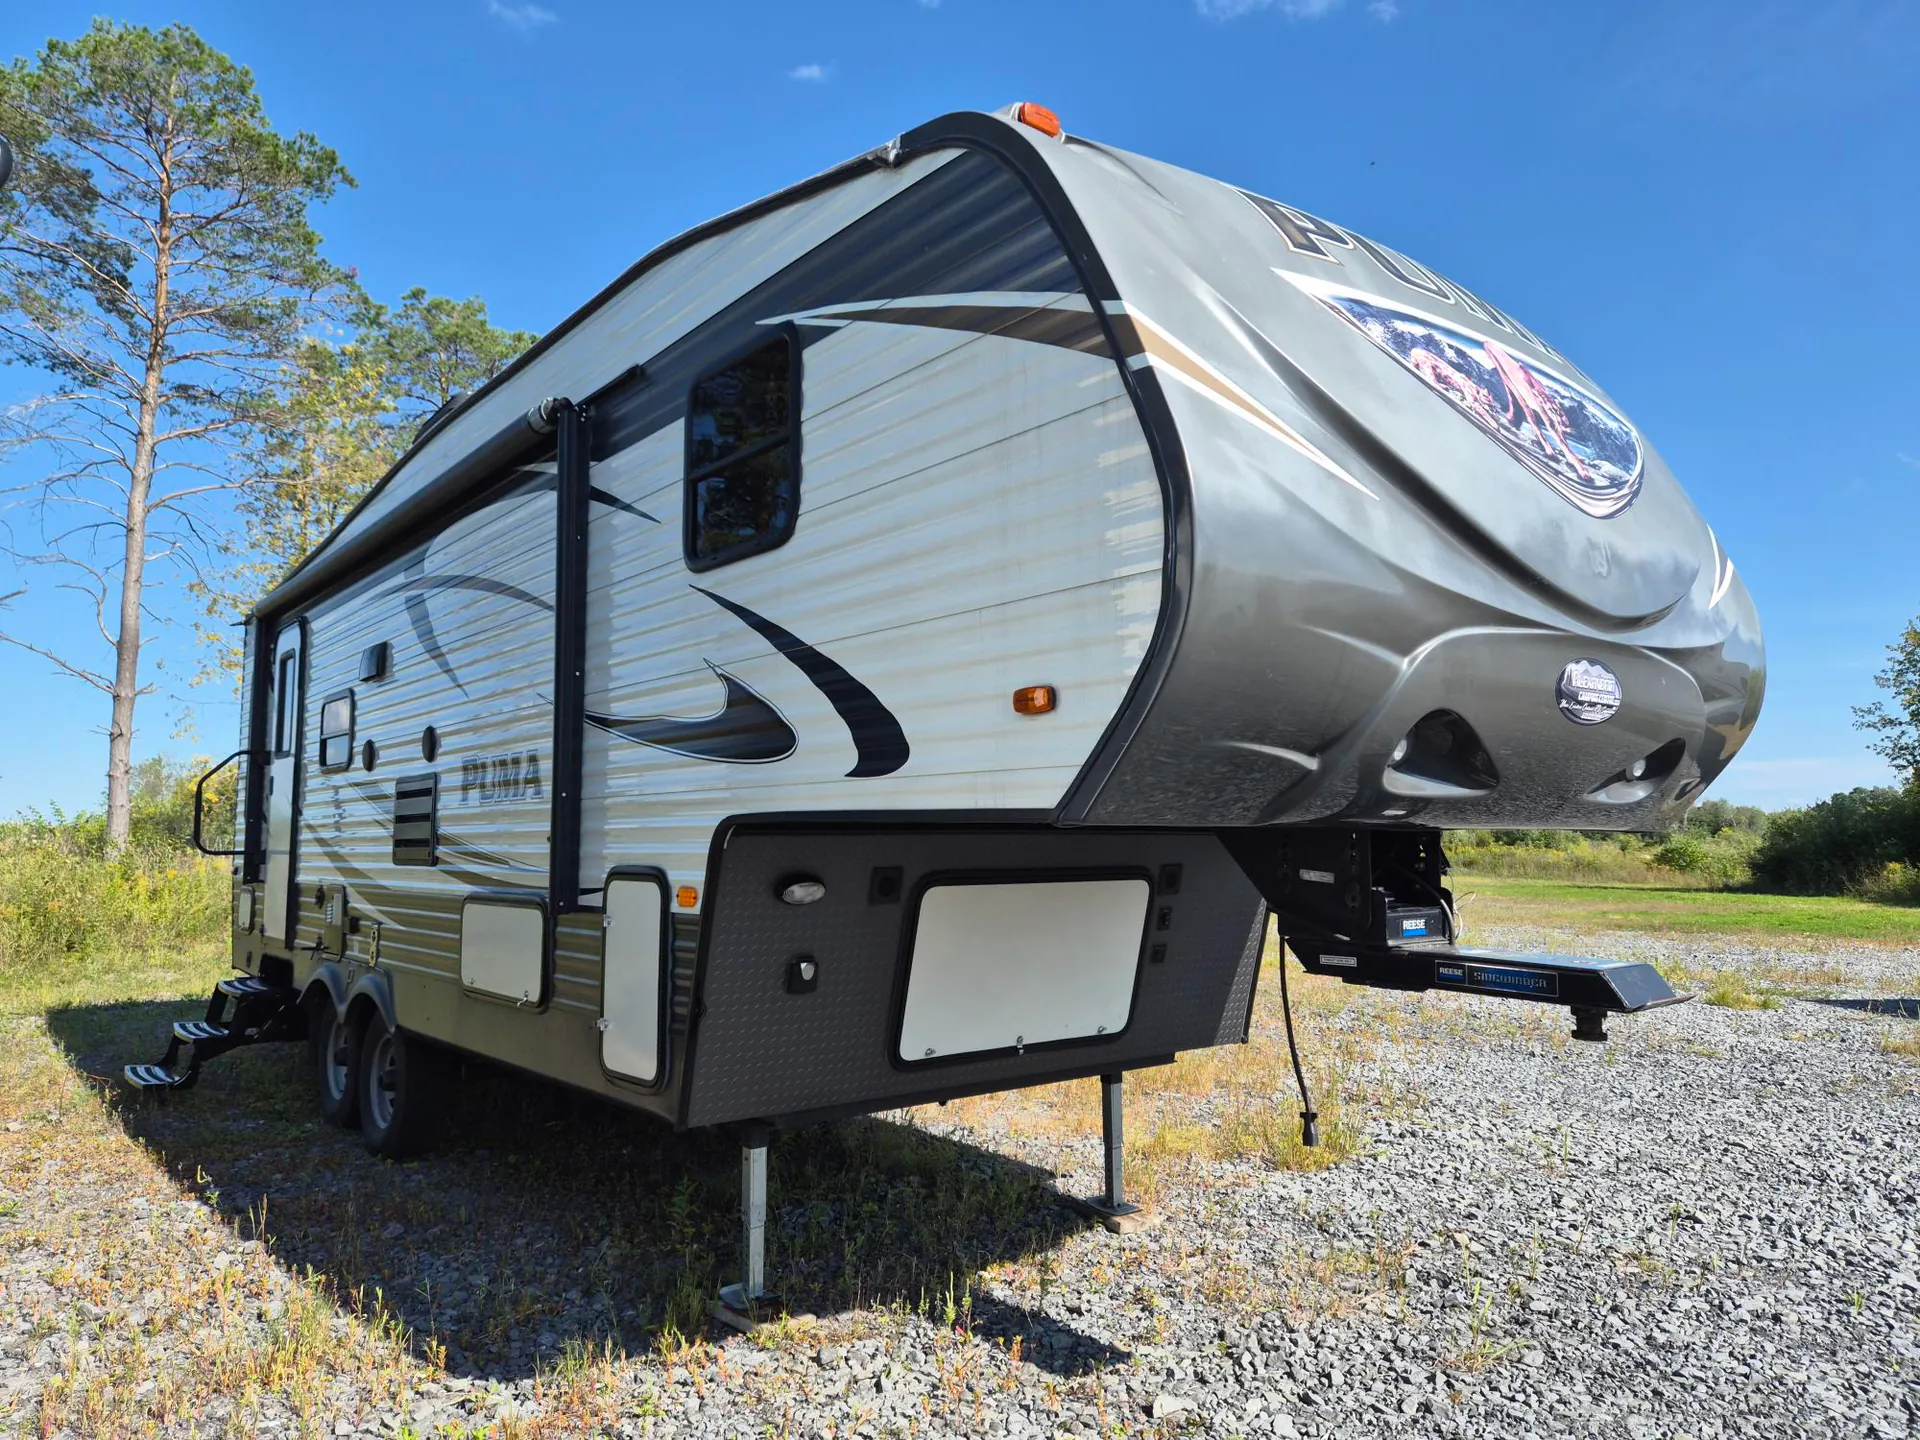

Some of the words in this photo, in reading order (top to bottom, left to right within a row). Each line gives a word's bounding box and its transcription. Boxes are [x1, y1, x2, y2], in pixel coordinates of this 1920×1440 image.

[1232, 183, 1590, 376] PUM
[459, 748, 544, 806] PUMA
[1403, 919, 1426, 930] REESE
[1440, 967, 1463, 976] REESE
